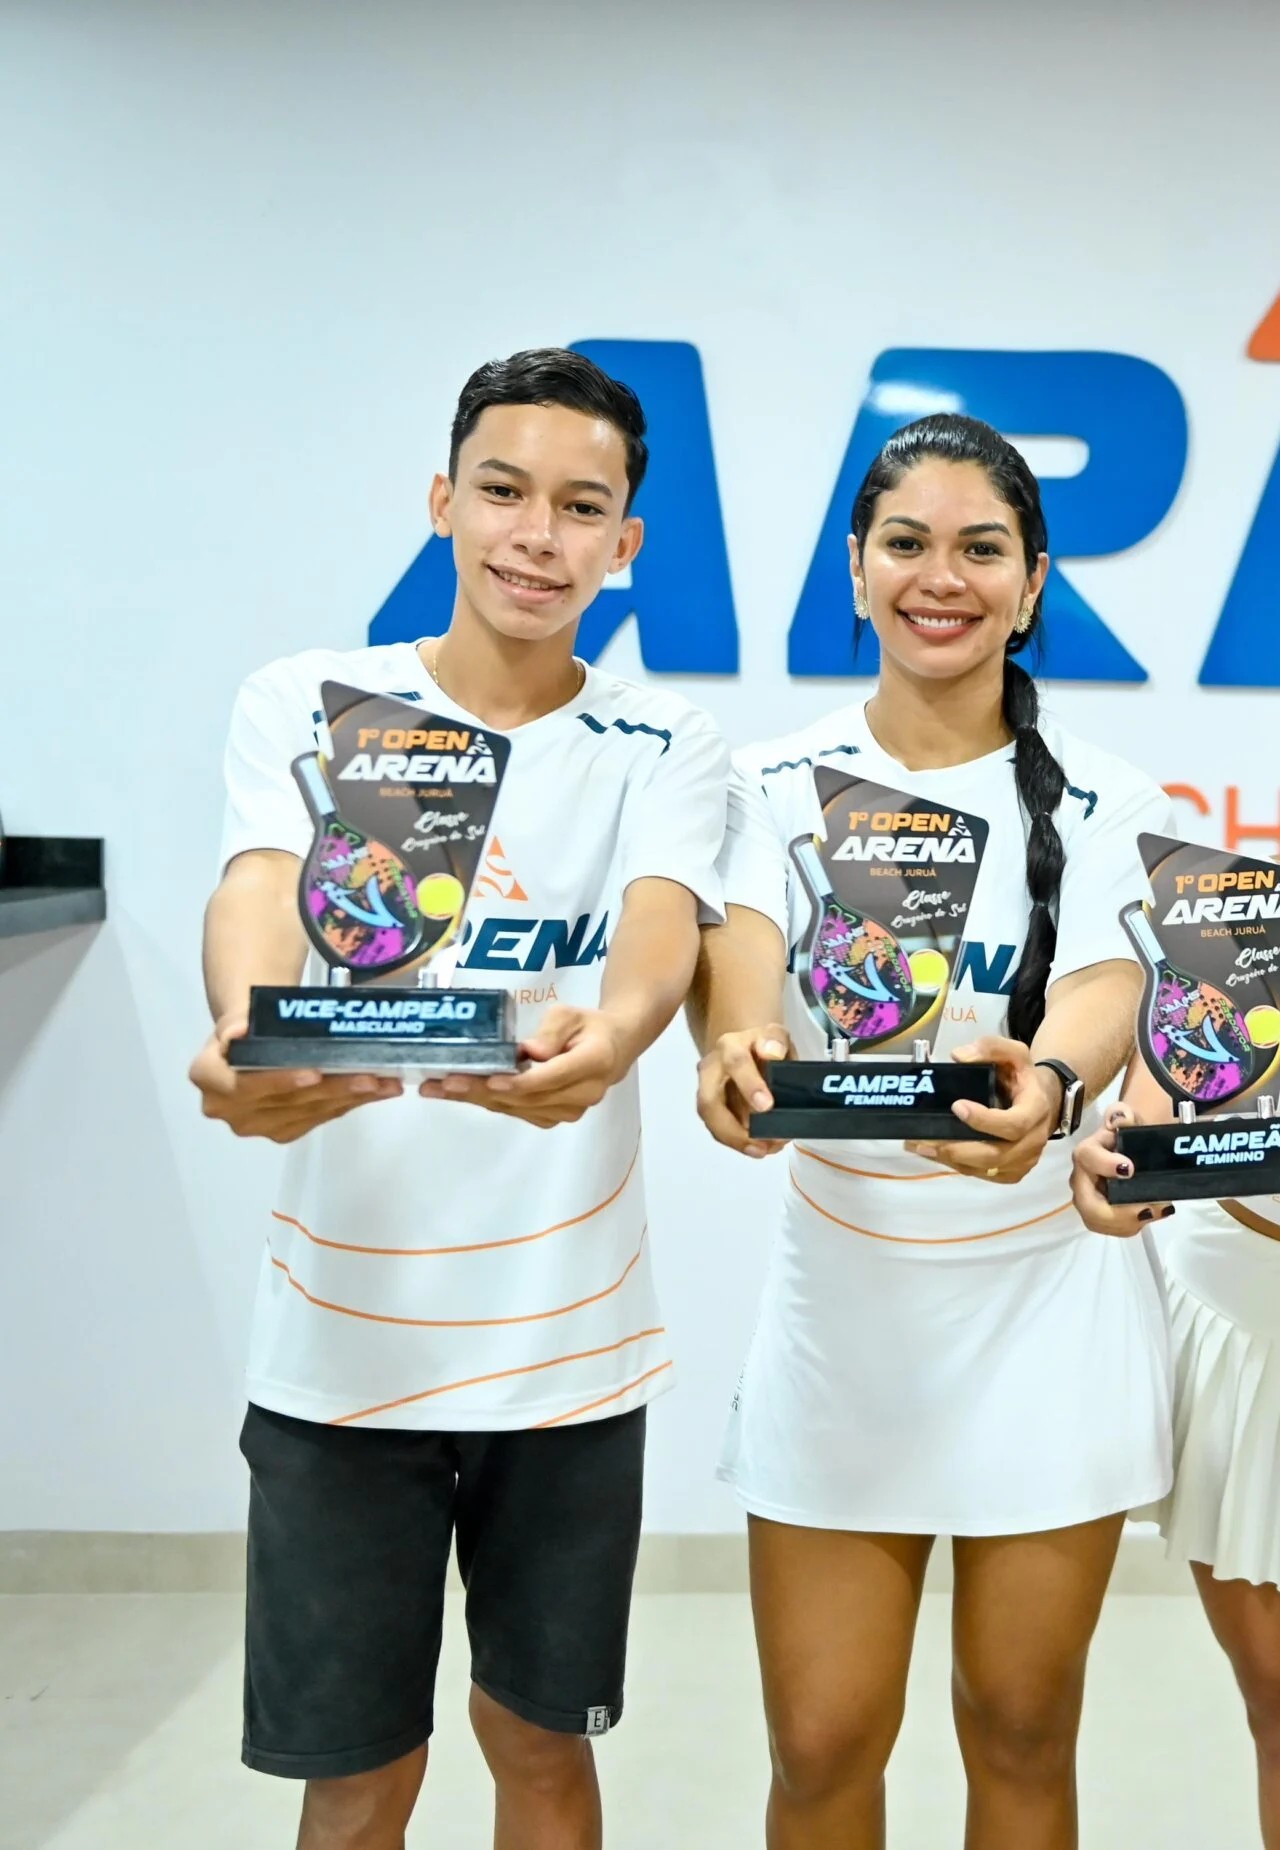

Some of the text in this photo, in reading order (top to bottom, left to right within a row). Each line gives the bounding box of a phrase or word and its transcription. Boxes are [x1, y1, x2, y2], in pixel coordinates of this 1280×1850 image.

[382, 729, 470, 751] OPEN
[337, 754, 497, 783] ARENA
[870, 812, 951, 831] OPEN
[831, 836, 976, 862] ARENA
[870, 867, 902, 877] BEACH
[1198, 870, 1275, 893] OPEN
[1200, 924, 1266, 938] BEACH JURUÁ
[278, 996, 477, 1019] VICE-CAMPEÃO
[329, 1020, 426, 1033] MASCULINO
[822, 1069, 935, 1093] CAMPEÃ
[844, 1094, 915, 1105] FEMININO
[1196, 1151, 1264, 1165] FEMININO
